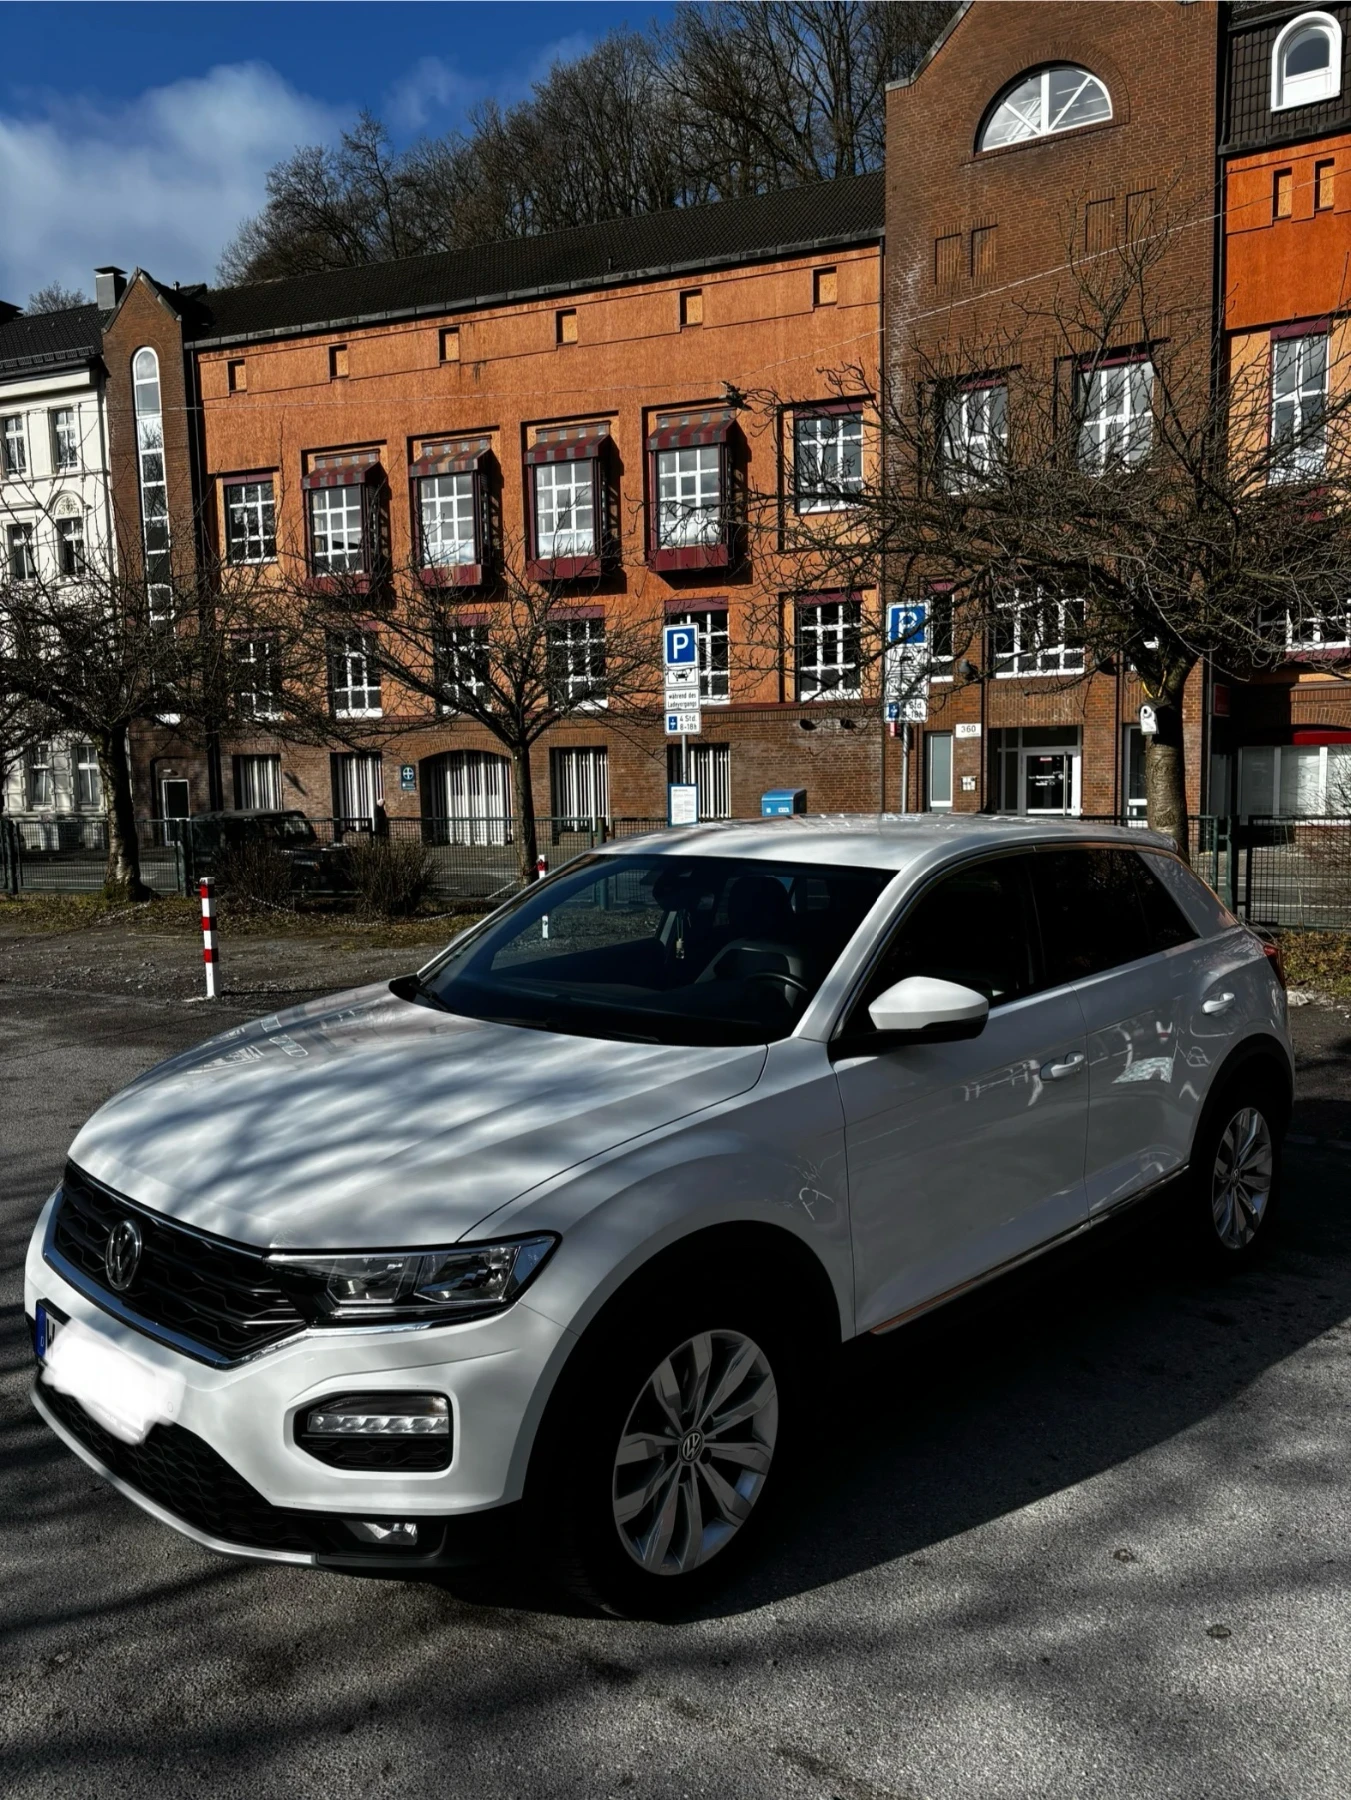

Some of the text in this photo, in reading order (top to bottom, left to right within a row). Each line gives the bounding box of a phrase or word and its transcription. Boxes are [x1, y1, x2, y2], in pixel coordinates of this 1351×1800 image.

[898, 611, 917, 638] P
[673, 633, 688, 659] P
[961, 725, 976, 733] 360
